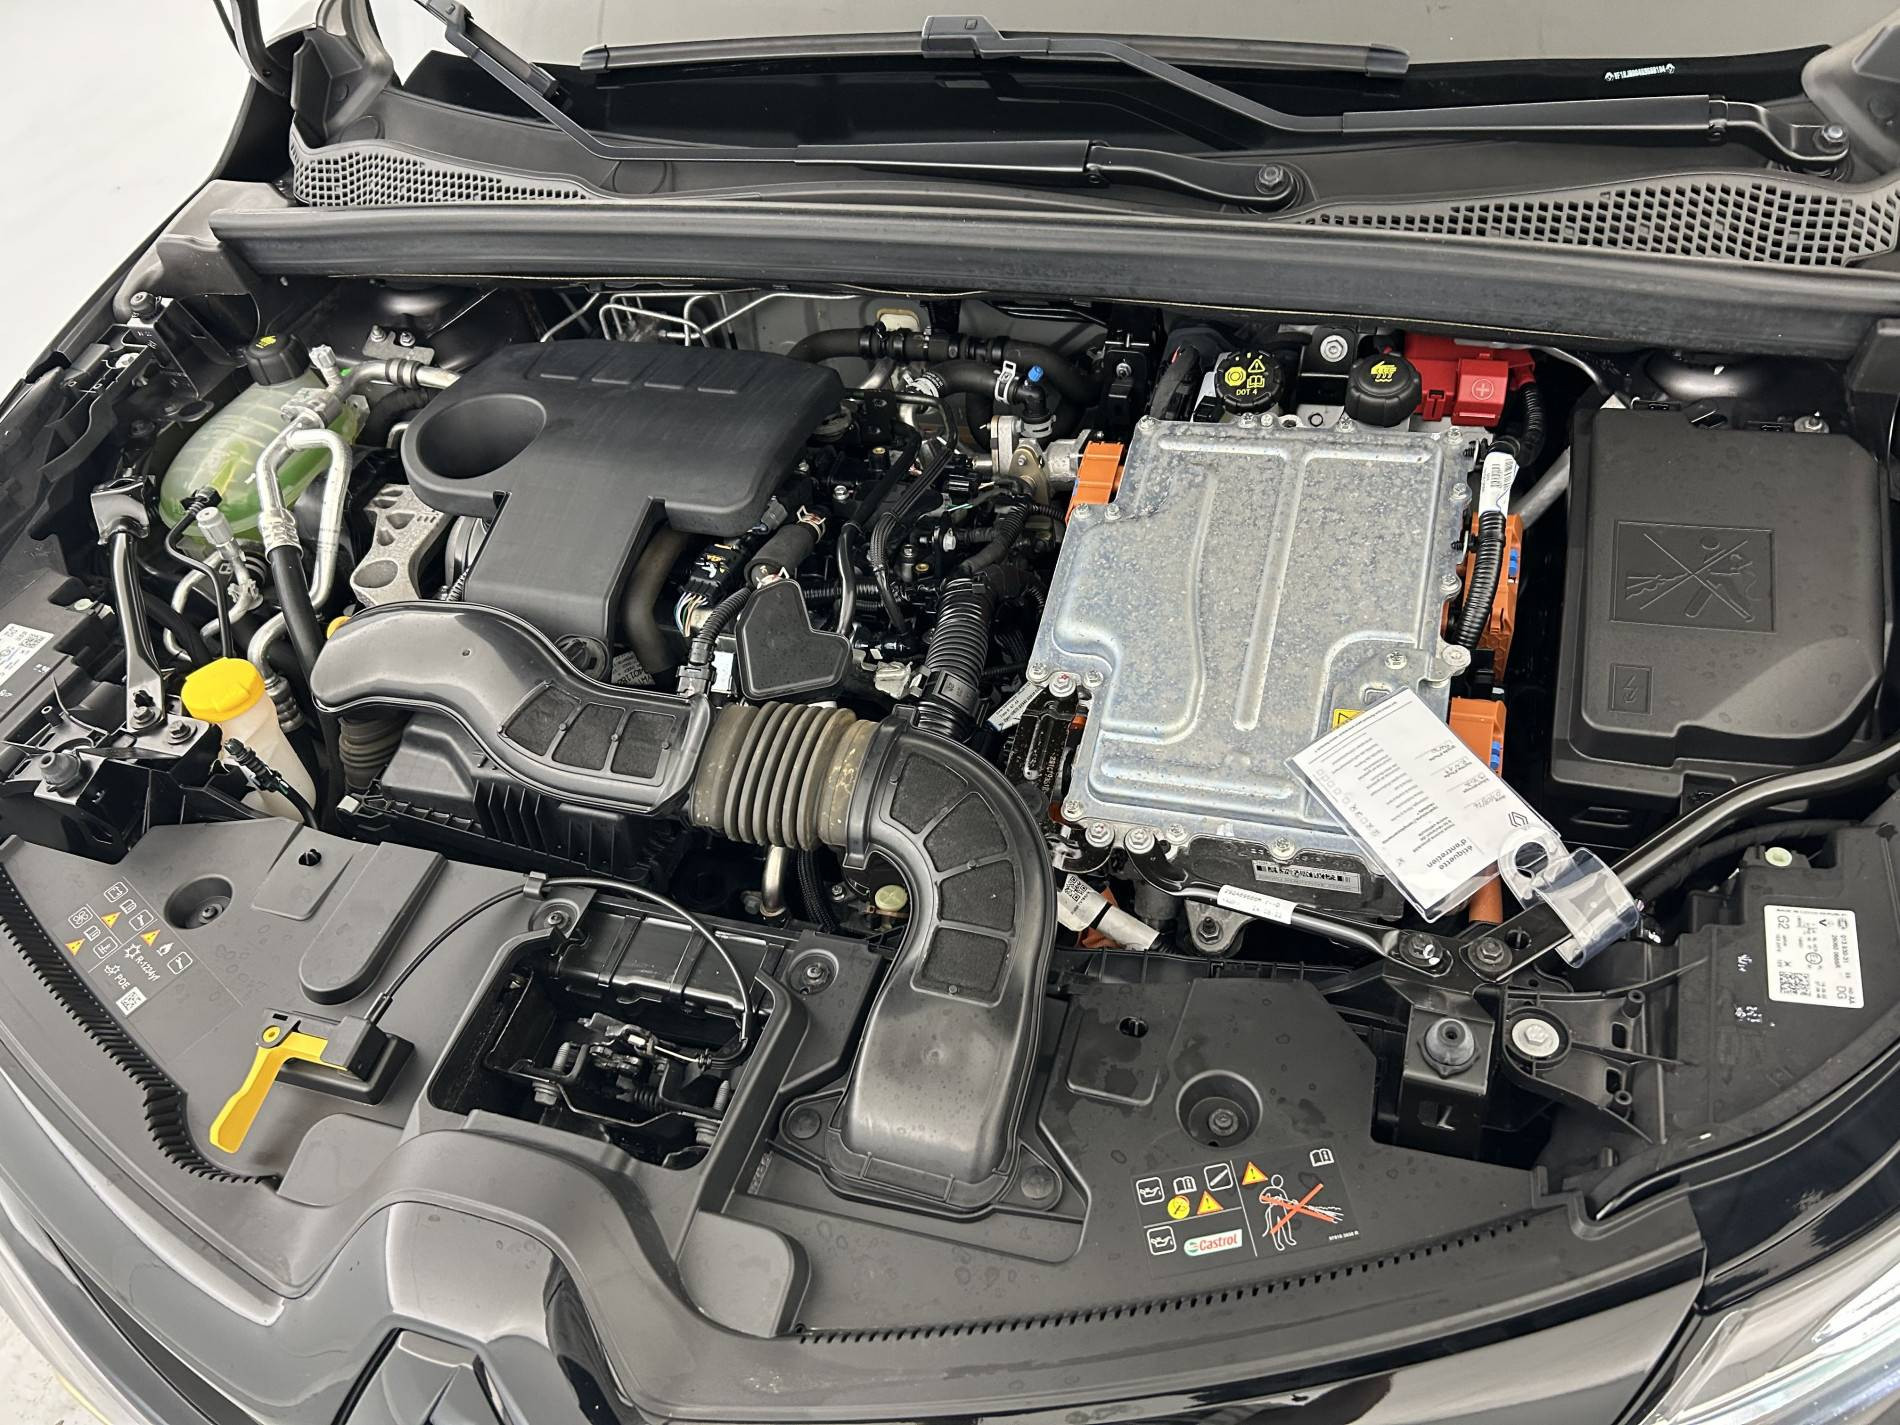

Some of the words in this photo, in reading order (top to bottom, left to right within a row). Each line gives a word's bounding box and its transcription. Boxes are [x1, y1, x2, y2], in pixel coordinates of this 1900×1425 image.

[1426, 838, 1467, 868] d'entretien
[1439, 845, 1473, 870] étiquette
[1777, 915, 1790, 929] G2
[1200, 1233, 1238, 1251] Castrol
